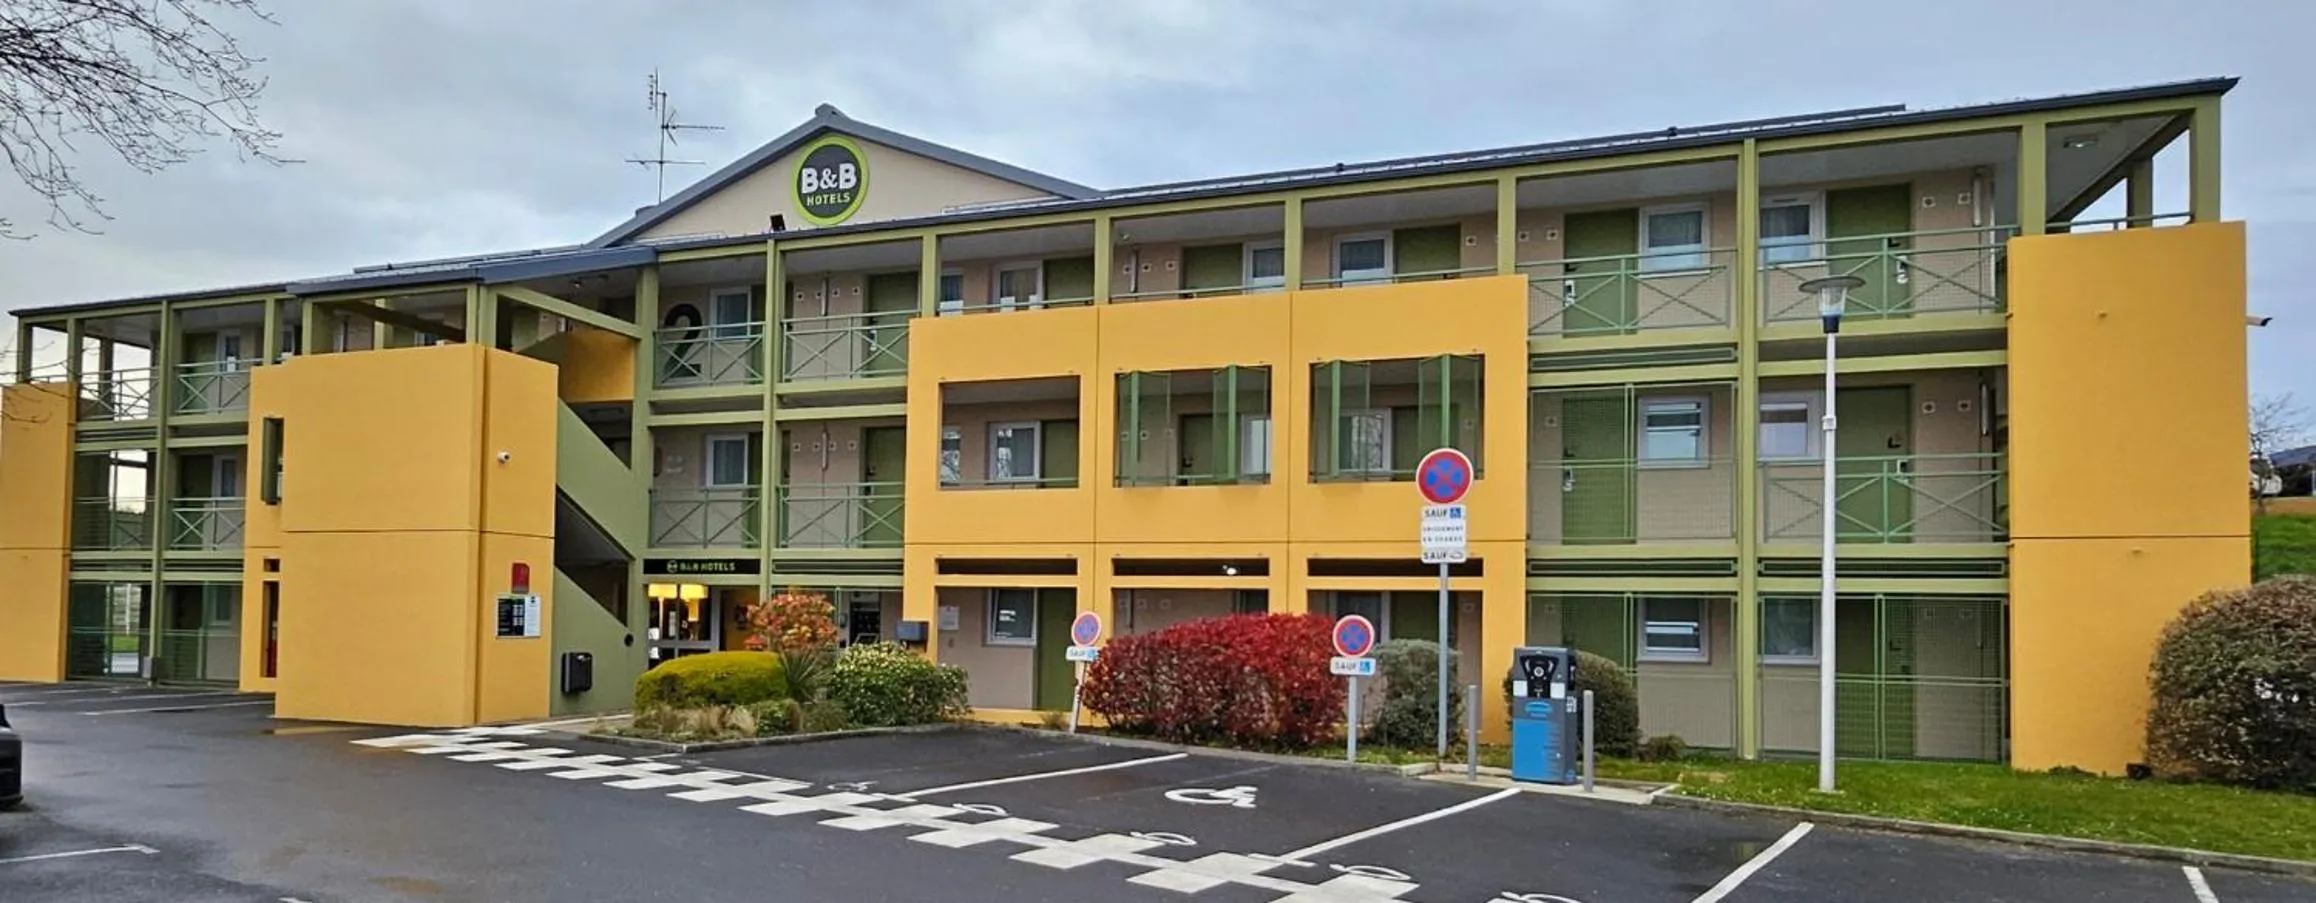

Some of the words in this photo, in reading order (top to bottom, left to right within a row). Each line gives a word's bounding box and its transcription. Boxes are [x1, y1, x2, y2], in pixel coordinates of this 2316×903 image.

[801, 163, 857, 194] B&B
[806, 192, 851, 206] HOTELS
[664, 303, 703, 379] 2
[1424, 508, 1448, 518] SAUF
[1423, 551, 1447, 560] SAUF
[701, 561, 737, 572] HOTELS
[1335, 660, 1357, 670] SAUF
